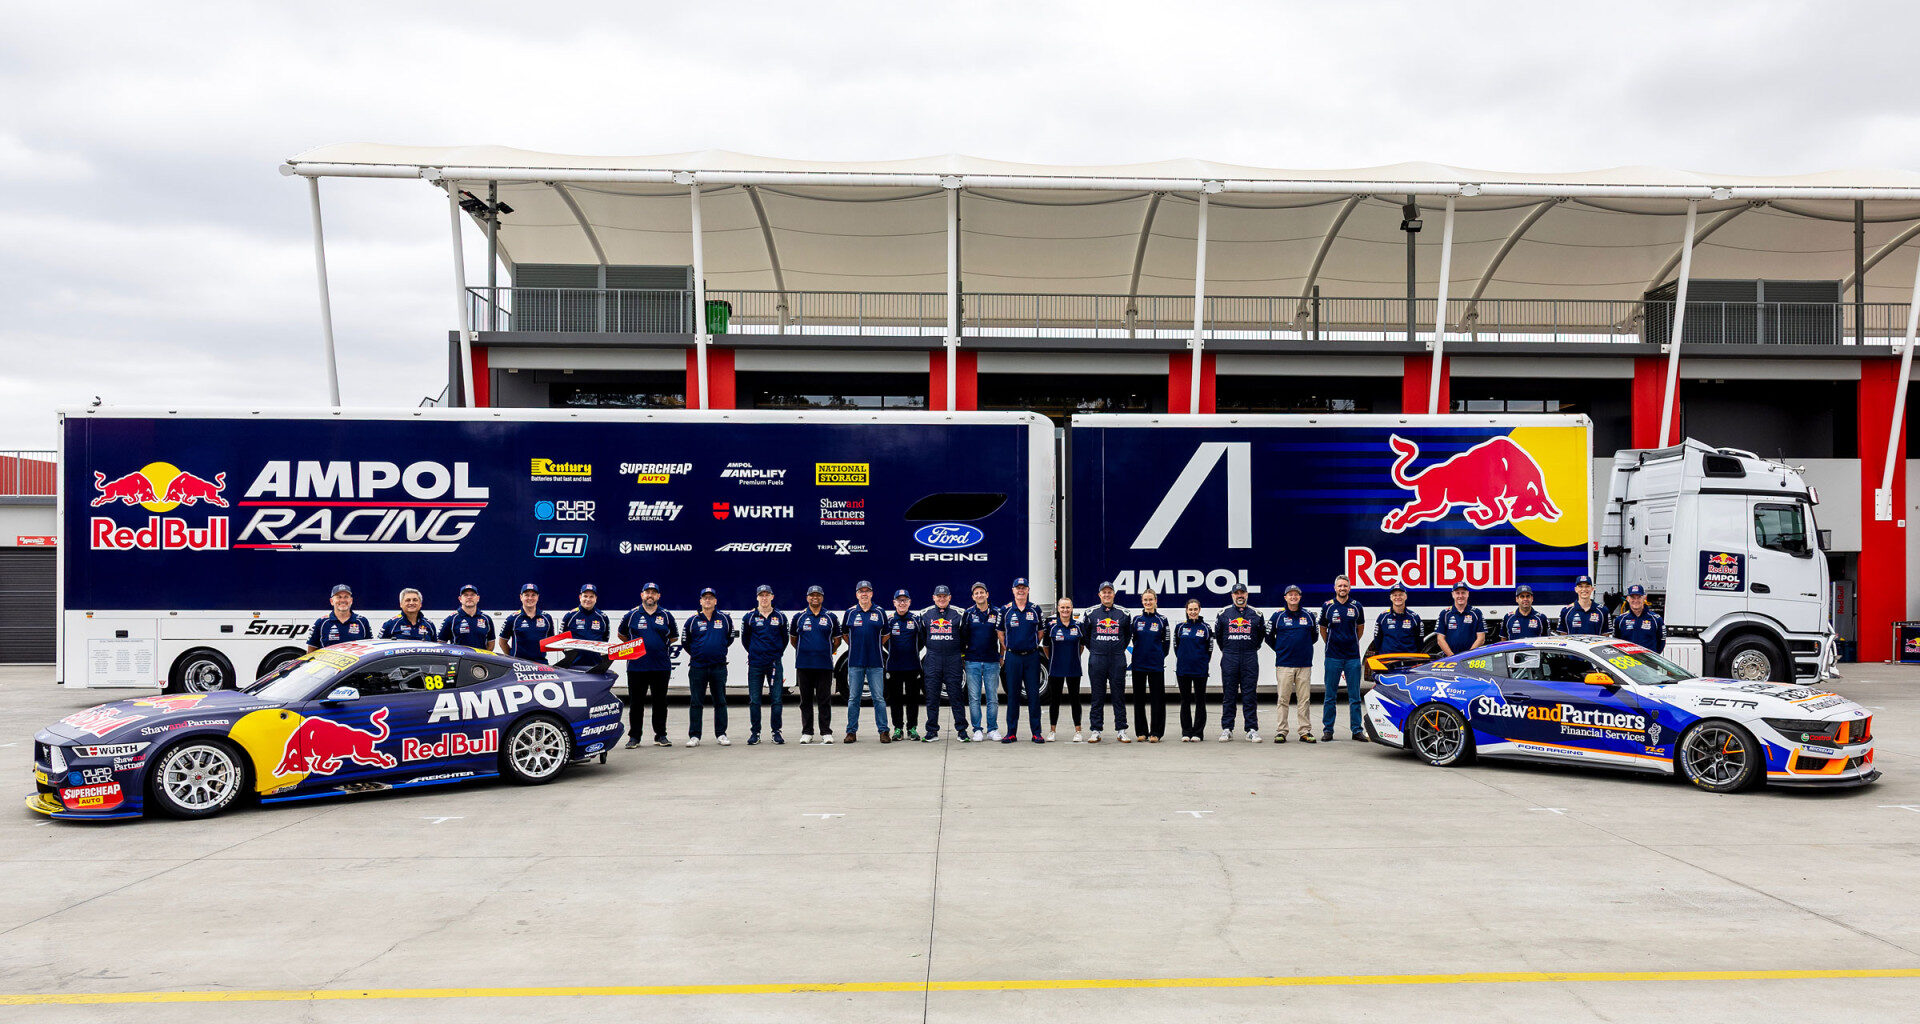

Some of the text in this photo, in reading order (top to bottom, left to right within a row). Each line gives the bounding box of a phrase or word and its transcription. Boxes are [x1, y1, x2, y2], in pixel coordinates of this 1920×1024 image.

[619, 462, 692, 475] SUPERCHEAP
[731, 469, 786, 478] AMPLIFY
[244, 460, 490, 500] AMPOL
[820, 474, 865, 482] STORAGE
[556, 500, 596, 512] QUAD
[628, 501, 684, 521] Thrifty
[733, 506, 794, 518] WÜRTH
[556, 511, 596, 521] LOCK
[820, 508, 864, 519] Partners
[238, 509, 481, 541] RACING
[91, 516, 230, 550] Red Bull
[928, 526, 969, 544] Ford
[540, 538, 584, 554] JGI
[634, 544, 692, 552] NEW HOLLAND
[727, 543, 792, 552] FREIGHTER
[910, 554, 988, 562] RACING
[1345, 544, 1516, 590] Red Bull
[1708, 565, 1738, 574] Red Bull
[1112, 569, 1261, 594] AMPOL
[1704, 574, 1740, 582] AMPOL
[609, 640, 643, 654] SUPERCHEAP
[1469, 660, 1486, 668] 888
[1609, 655, 1642, 670] 888
[425, 675, 444, 690] 88
[514, 672, 560, 682] Partners
[428, 681, 588, 724] AMPOL
[594, 702, 620, 711] AMPLIFY
[1699, 698, 1758, 710] SCTR
[608, 708, 620, 716] Fuels
[581, 722, 618, 737] Snap-on
[1560, 725, 1646, 742] Financial Services
[99, 744, 138, 754] WÜRTH
[402, 733, 450, 762] Red
[451, 728, 499, 756] Bull
[1546, 748, 1584, 756] RACING
[157, 746, 180, 784] DUNLOP
[83, 767, 112, 778] QUAD
[417, 772, 474, 782] FREIGHTER
[84, 776, 114, 786] LOCK
[63, 784, 120, 800] SUPERCHEAP
